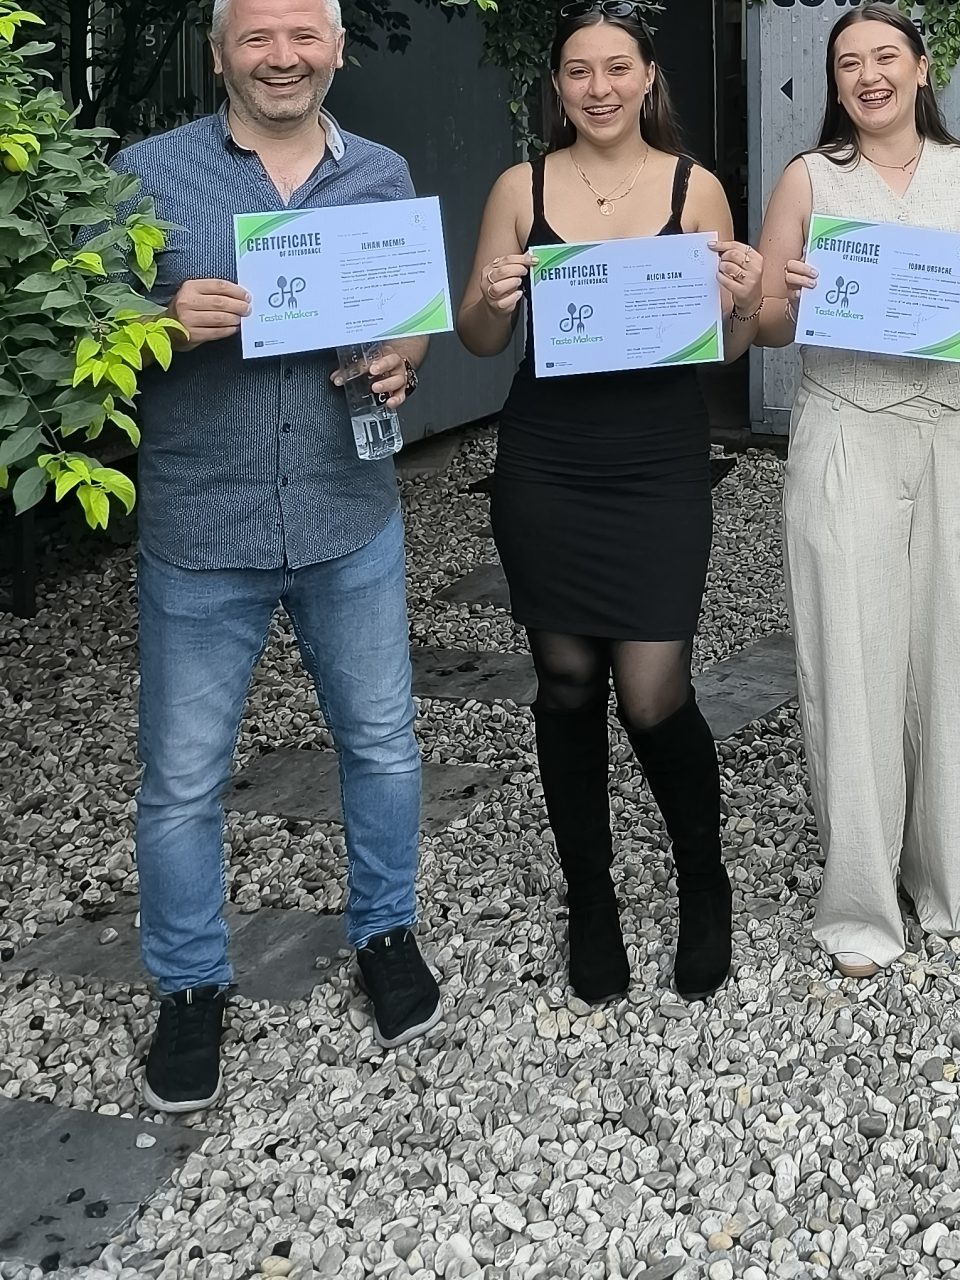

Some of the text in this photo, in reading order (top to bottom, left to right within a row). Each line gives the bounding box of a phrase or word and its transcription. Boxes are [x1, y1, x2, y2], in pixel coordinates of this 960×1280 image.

[246, 232, 322, 252] CERTIFICATE
[382, 238, 406, 248] MEMIS
[816, 237, 880, 257] CERTIFICATE
[280, 248, 322, 258] OF ATTENDANCE
[850, 255, 878, 264] ATTENDANCE
[540, 264, 608, 281] CERTIFICATE
[646, 272, 682, 281] ALICIA STAN
[578, 277, 608, 286] ATTENDANCE
[258, 309, 319, 323] Taste Makers
[814, 306, 864, 320] Taste Makers
[550, 334, 604, 346] Taste Makers
